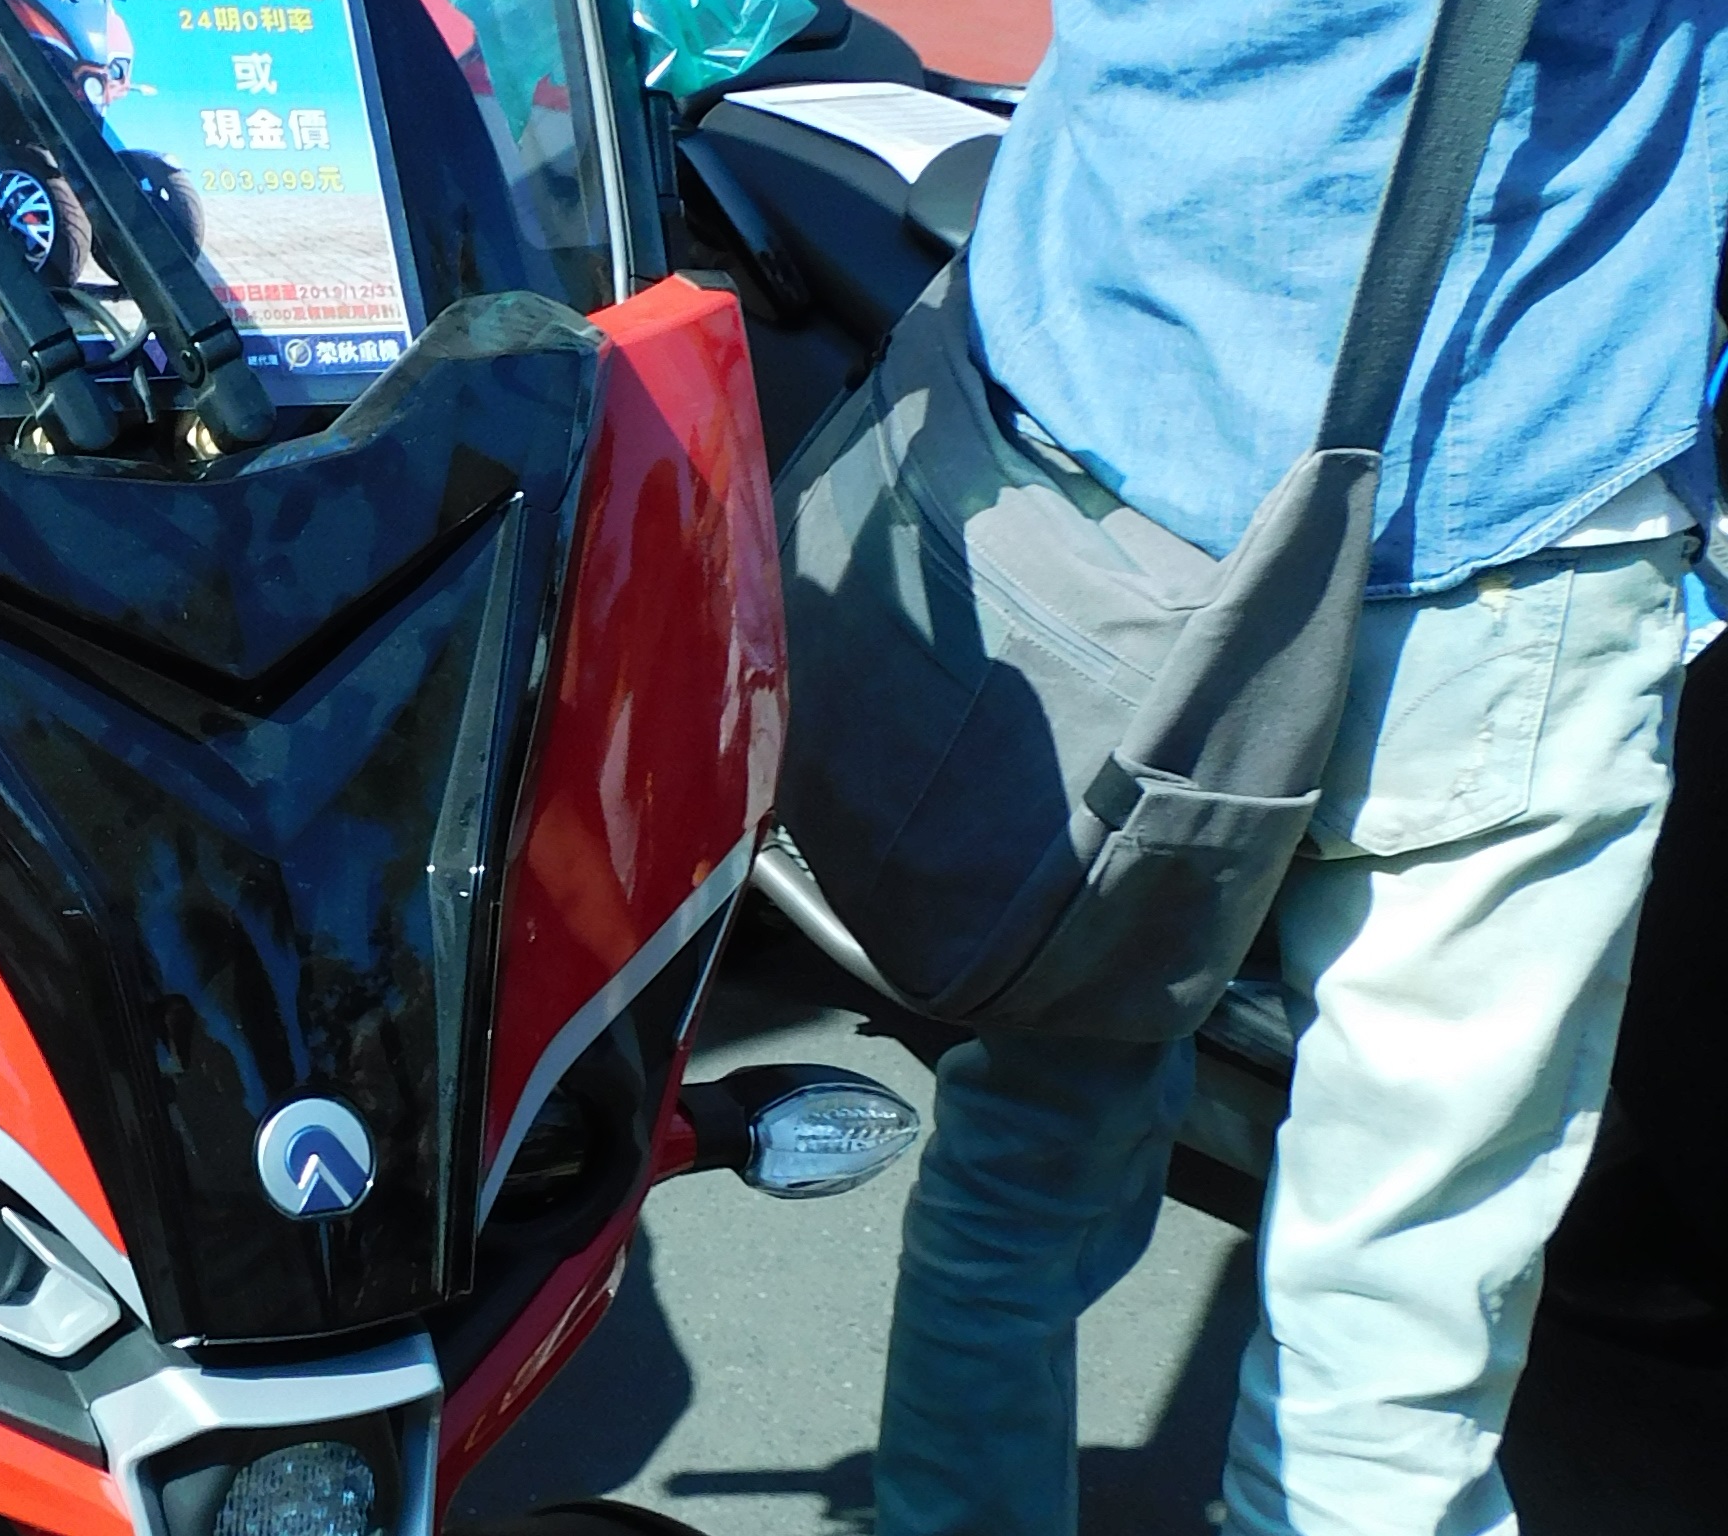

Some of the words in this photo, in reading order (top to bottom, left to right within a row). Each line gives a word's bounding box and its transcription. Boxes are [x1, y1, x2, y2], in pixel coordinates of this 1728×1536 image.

[178, 6, 314, 33] 24期0利率
[231, 52, 278, 95] 或
[200, 108, 331, 151] 現金價
[202, 166, 345, 193] 203,999元
